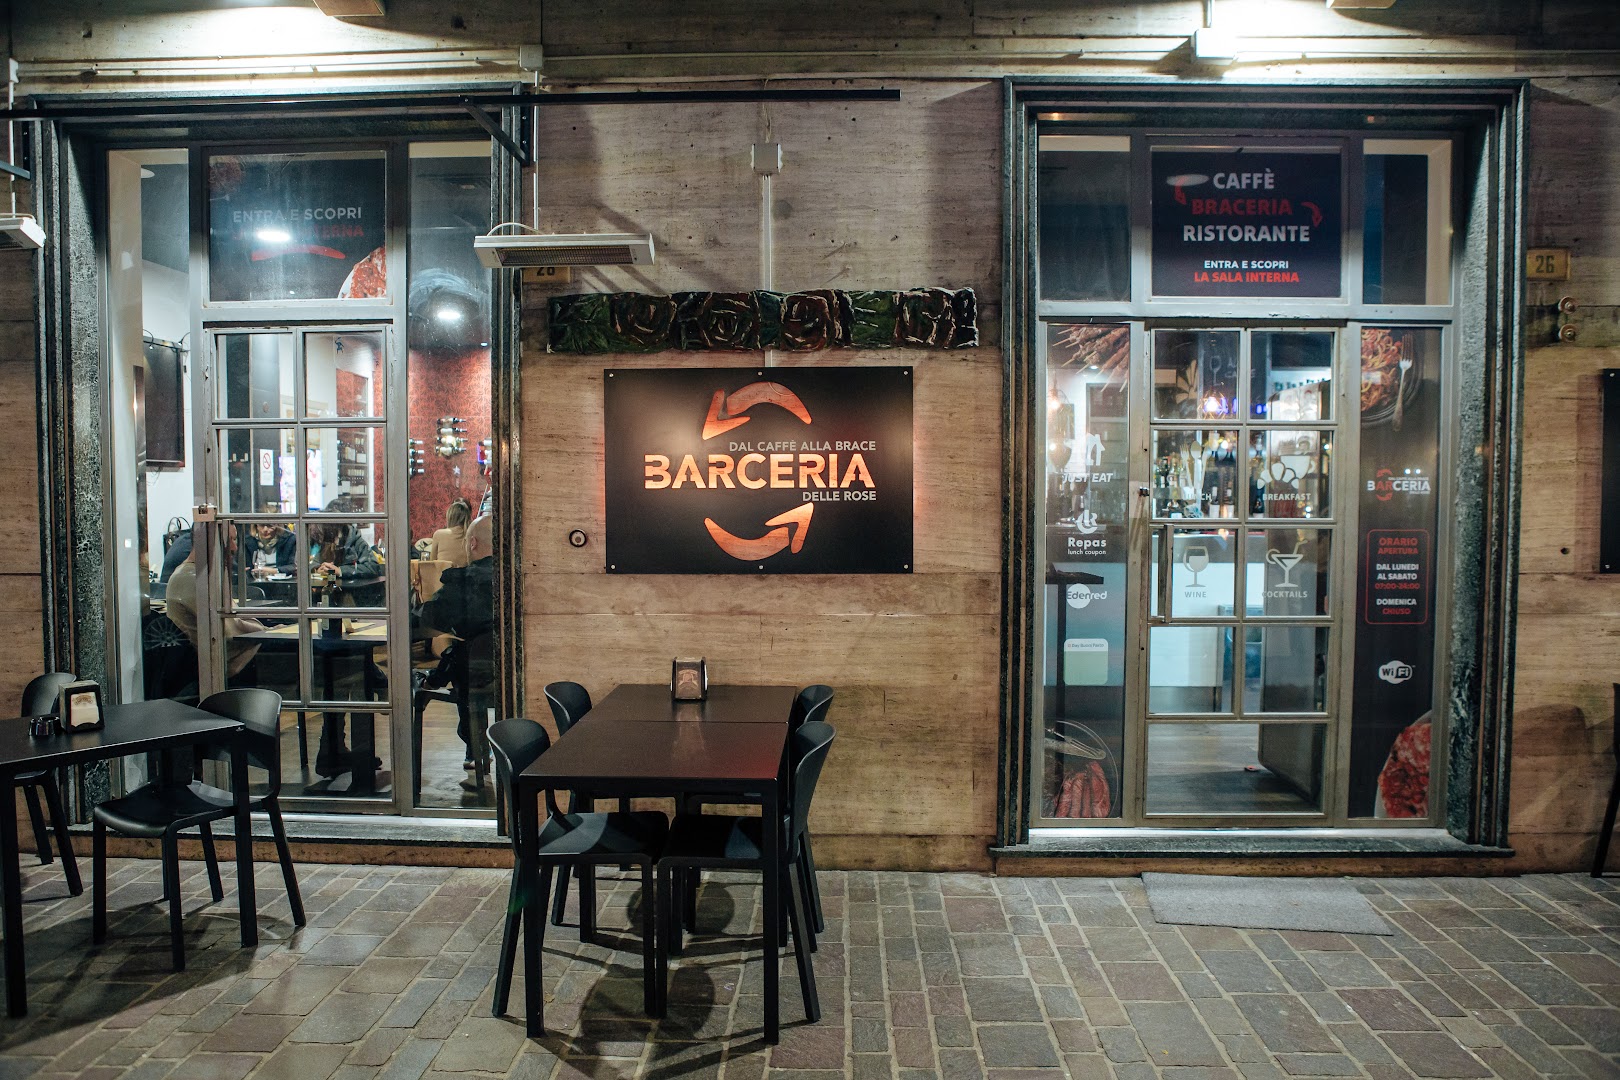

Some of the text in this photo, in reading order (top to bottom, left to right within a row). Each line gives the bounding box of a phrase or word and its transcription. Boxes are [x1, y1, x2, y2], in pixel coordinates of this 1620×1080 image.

[1213, 168, 1275, 189] CAFFÈ
[1192, 199, 1293, 215] BRACERIA
[233, 207, 362, 223] ENTRA E SCOPRI
[1183, 225, 1310, 242] RISTORANTE
[1204, 260, 1289, 269] ENTRA E SCOPRI
[1535, 255, 1555, 273] 26
[1194, 272, 1299, 283] LA SALA INTERNA
[729, 439, 876, 452] DAL CAFFÈ ALLA BRACE
[644, 453, 876, 490] BARCERIA
[1062, 473, 1114, 483] JUST EAT
[1367, 480, 1431, 491] BARCERIA
[802, 490, 877, 502] DELLE ROSE
[1263, 493, 1311, 501] BREAKFAST
[1068, 537, 1107, 550] Repas
[1379, 537, 1418, 546] ORARIO
[1378, 547, 1418, 555] APERTURA
[1376, 563, 1391, 571] DAL
[1067, 590, 1108, 600] Edenred
[1376, 598, 1417, 606] DOMENICA
